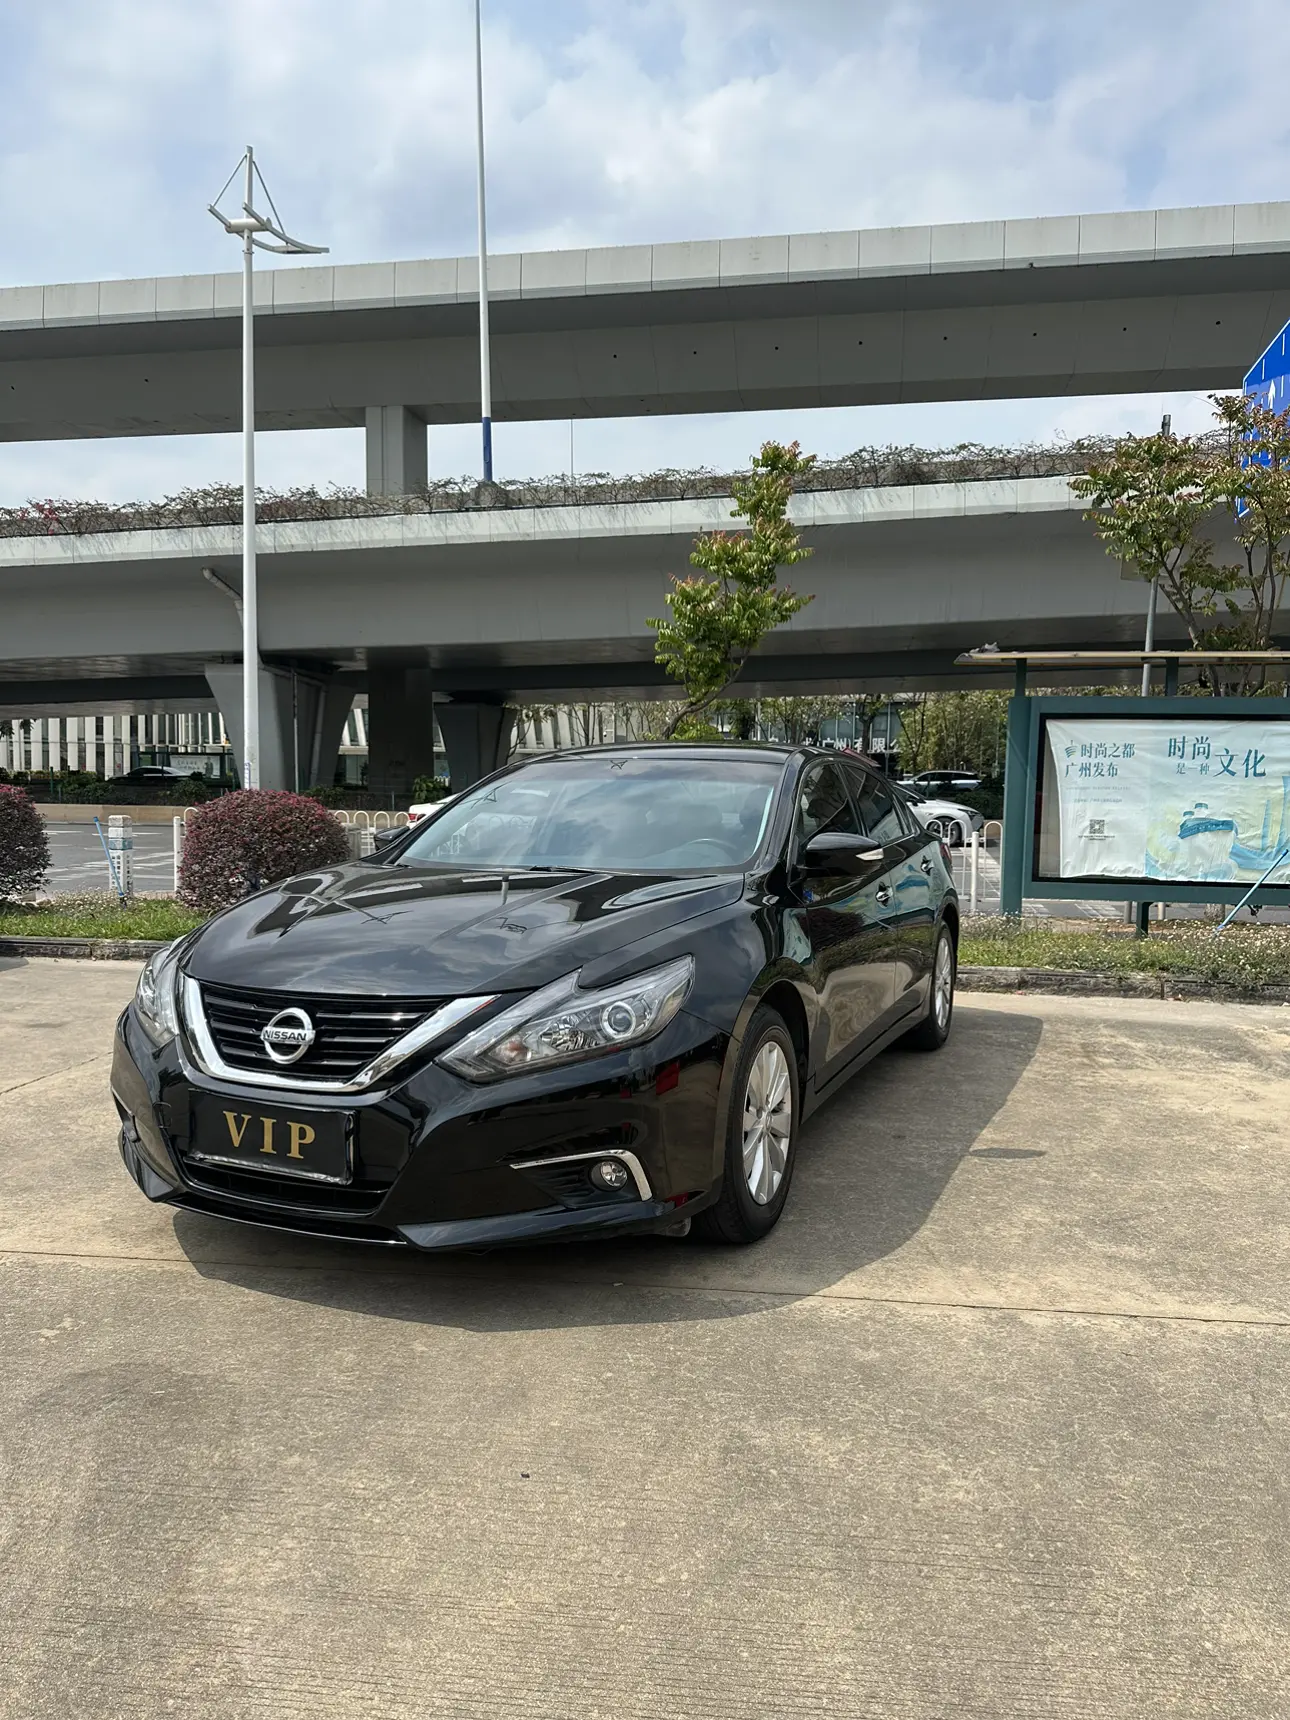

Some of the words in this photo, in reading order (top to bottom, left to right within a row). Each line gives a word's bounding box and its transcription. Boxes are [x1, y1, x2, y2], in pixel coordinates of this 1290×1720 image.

[1081, 743, 1135, 758] 时尚之都
[1168, 736, 1211, 760] 时尚
[1065, 762, 1118, 778] 广州发布
[1176, 763, 1209, 775] 是一种
[1213, 748, 1266, 778] 文化
[263, 1030, 307, 1041] NISSAN
[223, 1111, 316, 1159] VIP
